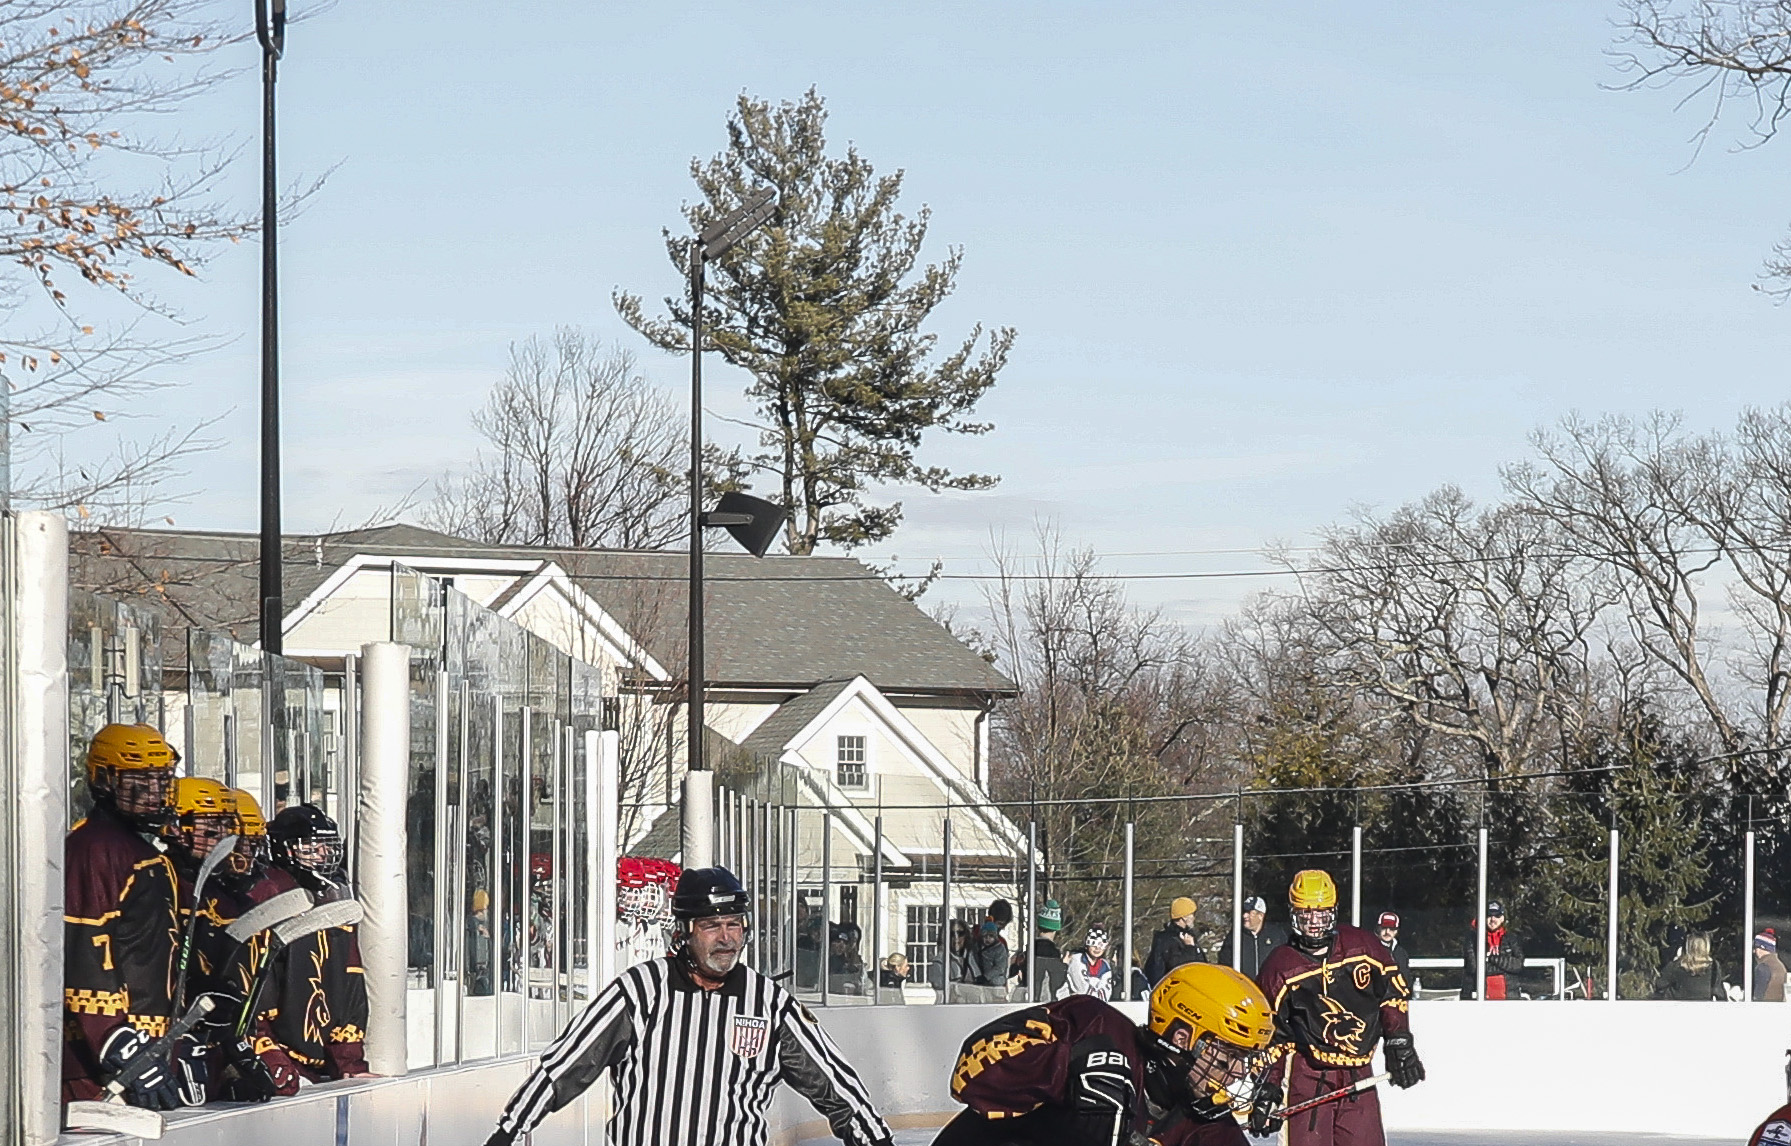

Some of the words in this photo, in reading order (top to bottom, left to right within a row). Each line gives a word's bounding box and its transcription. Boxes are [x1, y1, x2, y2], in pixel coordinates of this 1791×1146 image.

[92, 934, 114, 970] 7
[1353, 963, 1371, 990] C
[1177, 1002, 1202, 1021] CCM
